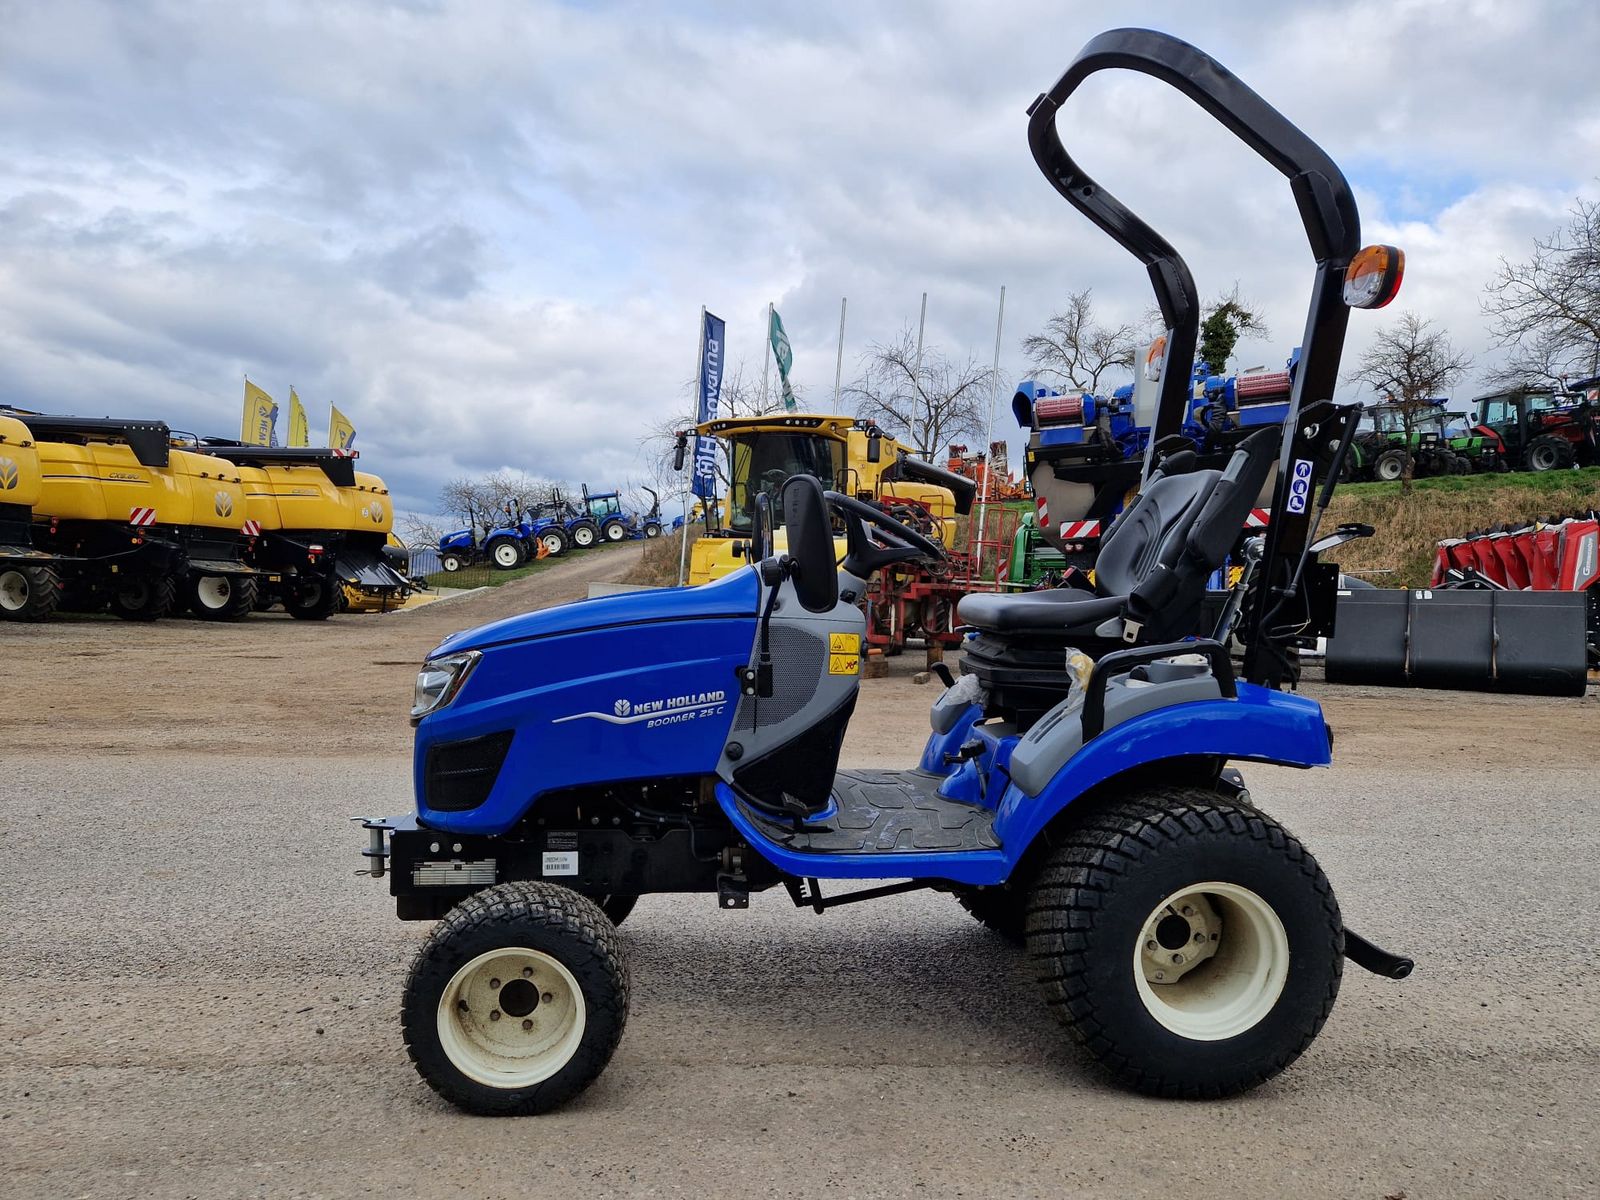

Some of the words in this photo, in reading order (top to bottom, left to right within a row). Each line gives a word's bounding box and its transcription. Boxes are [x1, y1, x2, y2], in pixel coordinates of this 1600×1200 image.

[699, 339, 719, 450] Hsqvarna
[634, 700, 664, 714] NEW
[667, 690, 725, 708] HOLLAND
[647, 712, 696, 728] BOOMER
[699, 708, 714, 719] 25
[717, 706, 724, 715] C
